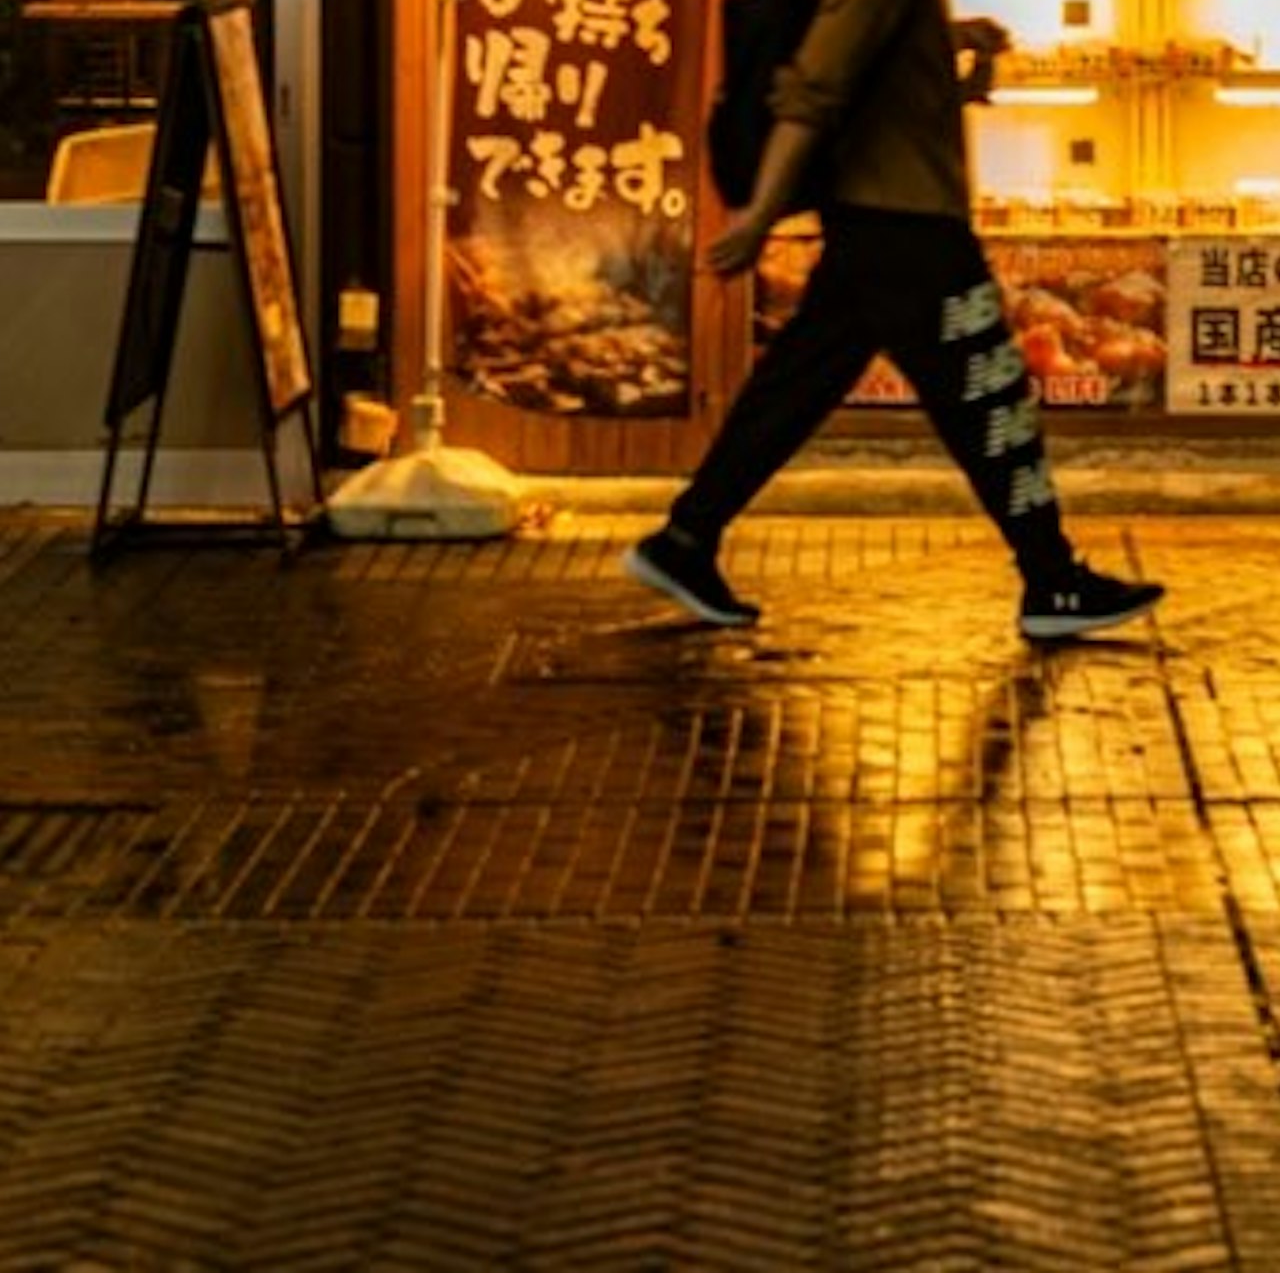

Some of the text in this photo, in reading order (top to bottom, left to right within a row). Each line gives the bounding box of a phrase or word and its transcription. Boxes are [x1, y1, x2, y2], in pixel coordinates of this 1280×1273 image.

[464, 26, 608, 127] 帰り
[465, 123, 688, 217] できます。
